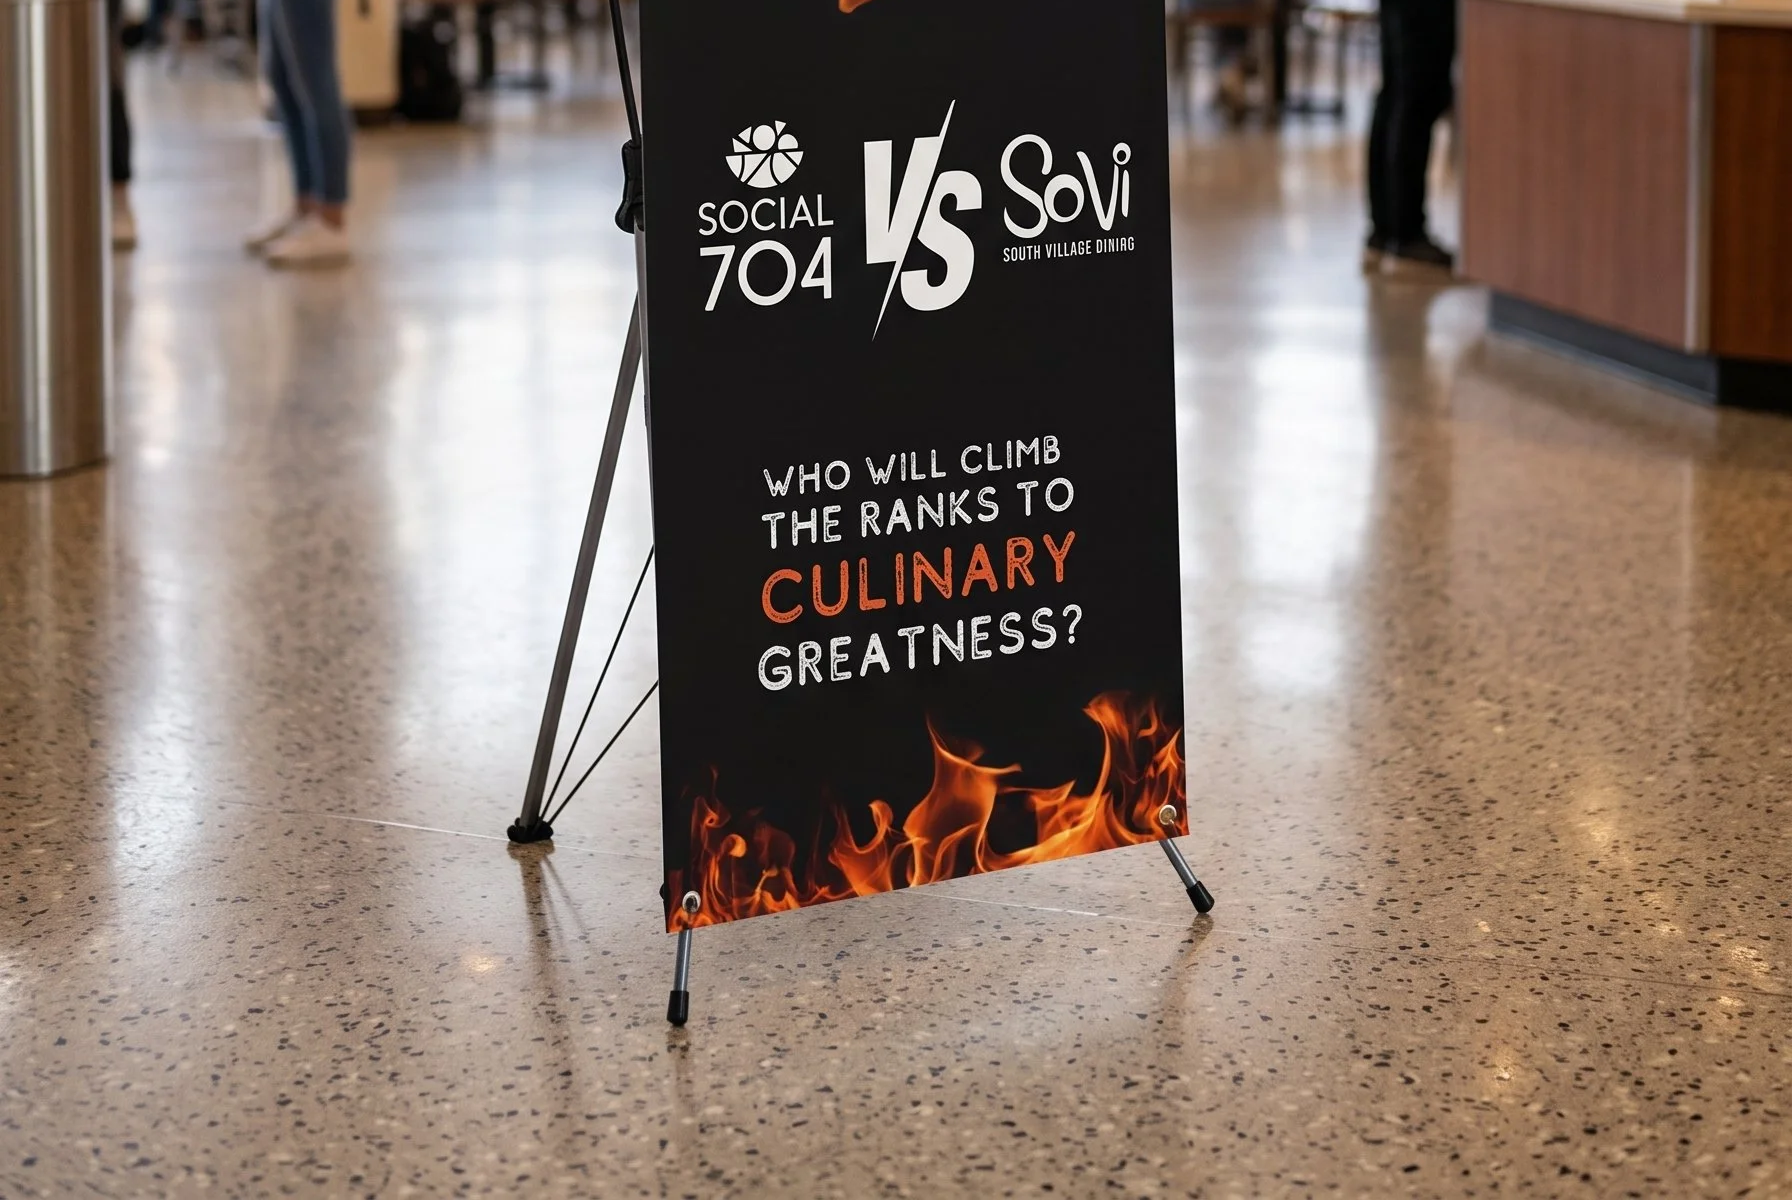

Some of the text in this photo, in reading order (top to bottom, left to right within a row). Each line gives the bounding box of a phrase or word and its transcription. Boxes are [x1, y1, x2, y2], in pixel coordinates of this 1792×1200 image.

[699, 194, 833, 236] SOCIAL
[700, 237, 831, 311] 704
[1004, 245, 1040, 262] SOUTH
[1046, 240, 1091, 258] VILLAGE
[764, 436, 1060, 496] WHO WILL CLIMB
[762, 478, 1074, 549] THE RANKS TO
[762, 531, 1075, 623] CULINARY
[759, 604, 1082, 690] GREATNESS?
